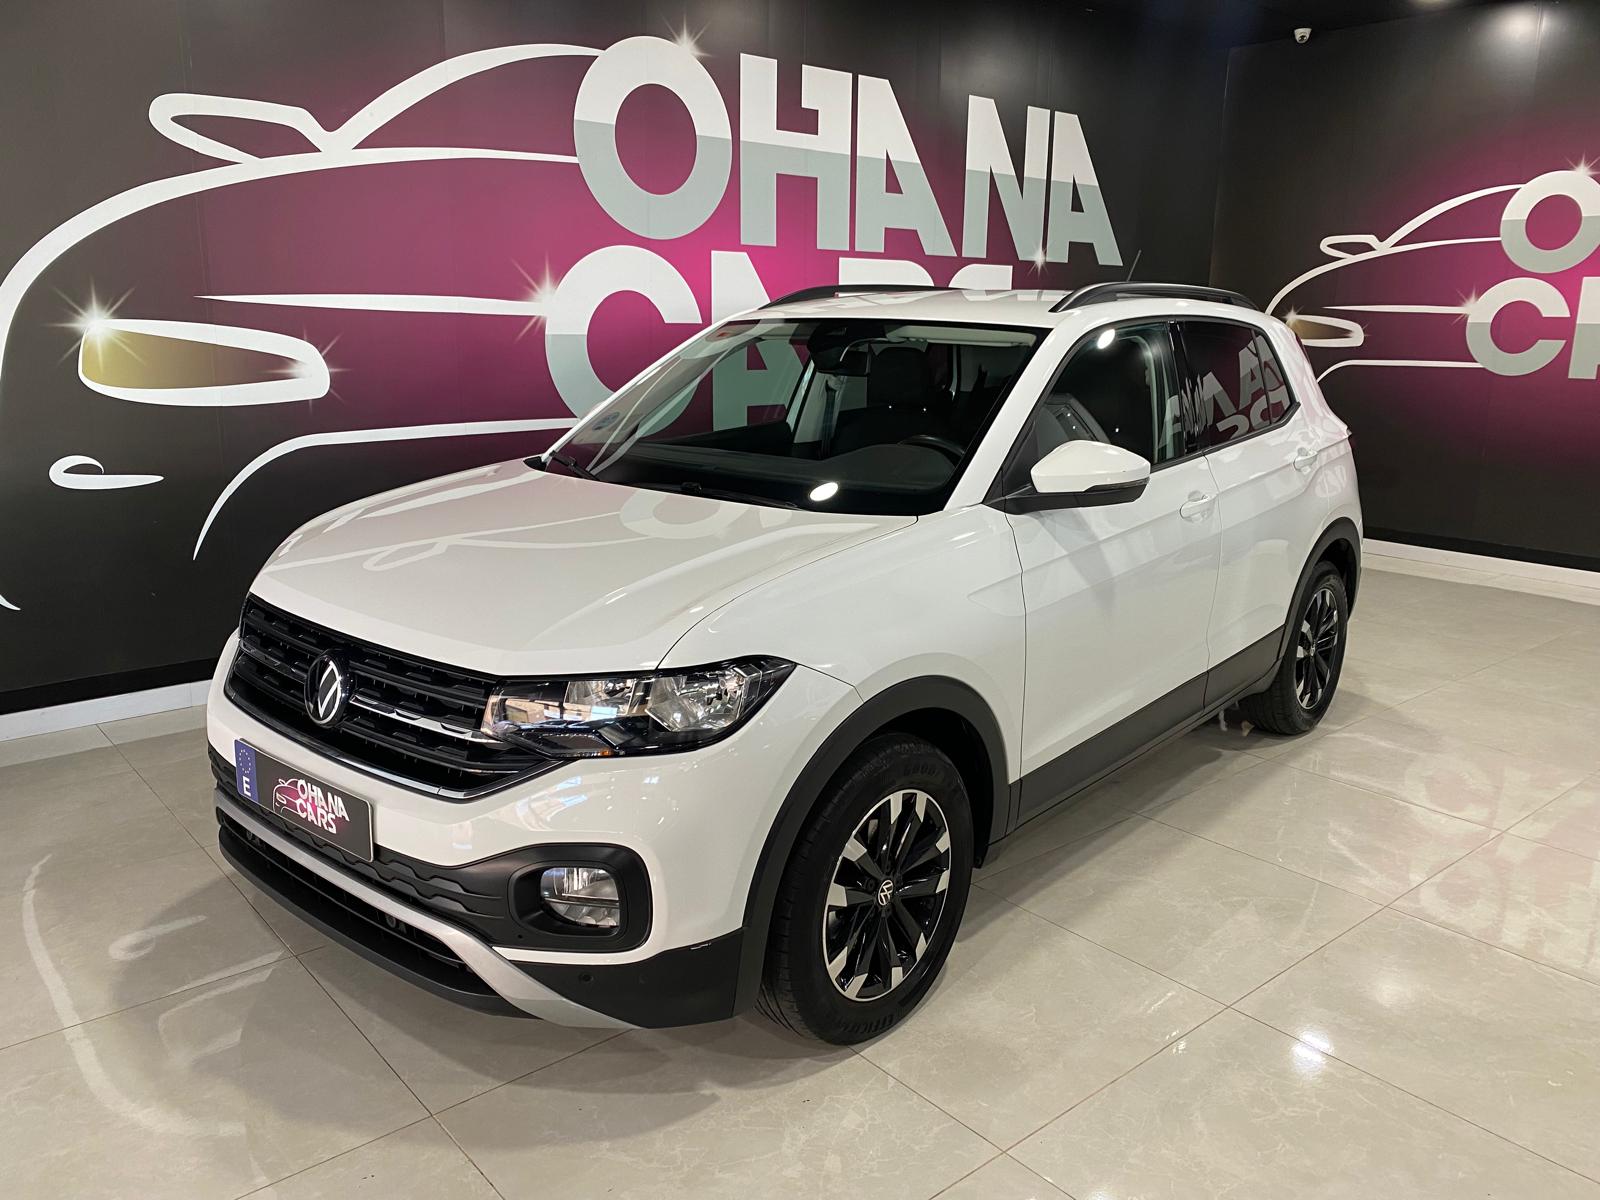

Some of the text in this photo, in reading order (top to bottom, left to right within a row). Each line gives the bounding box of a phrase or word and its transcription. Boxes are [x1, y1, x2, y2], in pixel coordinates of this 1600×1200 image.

[573, 35, 1123, 266] OHANA
[242, 775, 252, 797] E
[297, 779, 350, 822] OHANA
[296, 798, 337, 834] CARS
